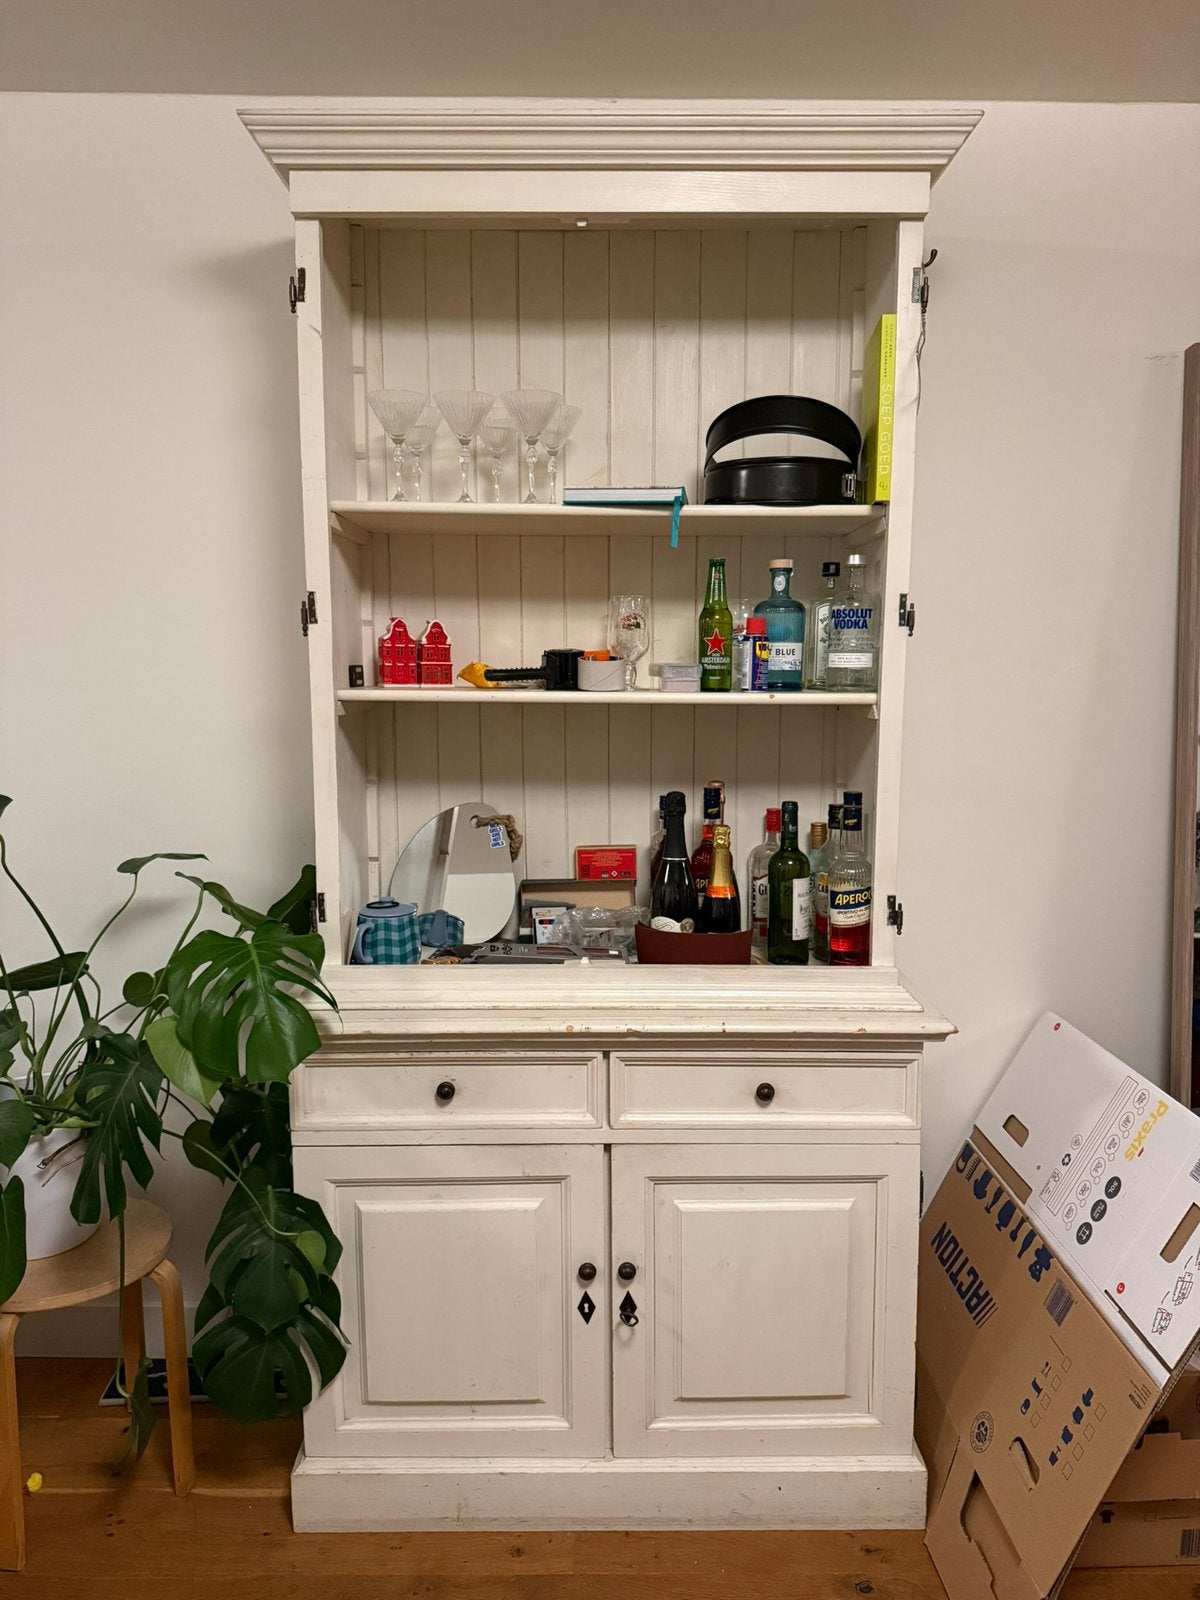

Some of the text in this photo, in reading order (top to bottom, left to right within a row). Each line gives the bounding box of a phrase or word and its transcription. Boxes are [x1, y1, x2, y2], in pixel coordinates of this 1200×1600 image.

[881, 384, 892, 425] SOEP
[879, 431, 891, 475] GOED
[831, 608, 872, 620] ABSOLUT
[834, 618, 868, 629] VODKA
[775, 648, 796, 656] BLUE
[1124, 1100, 1169, 1161] praxis
[931, 1221, 990, 1315] ACTION
